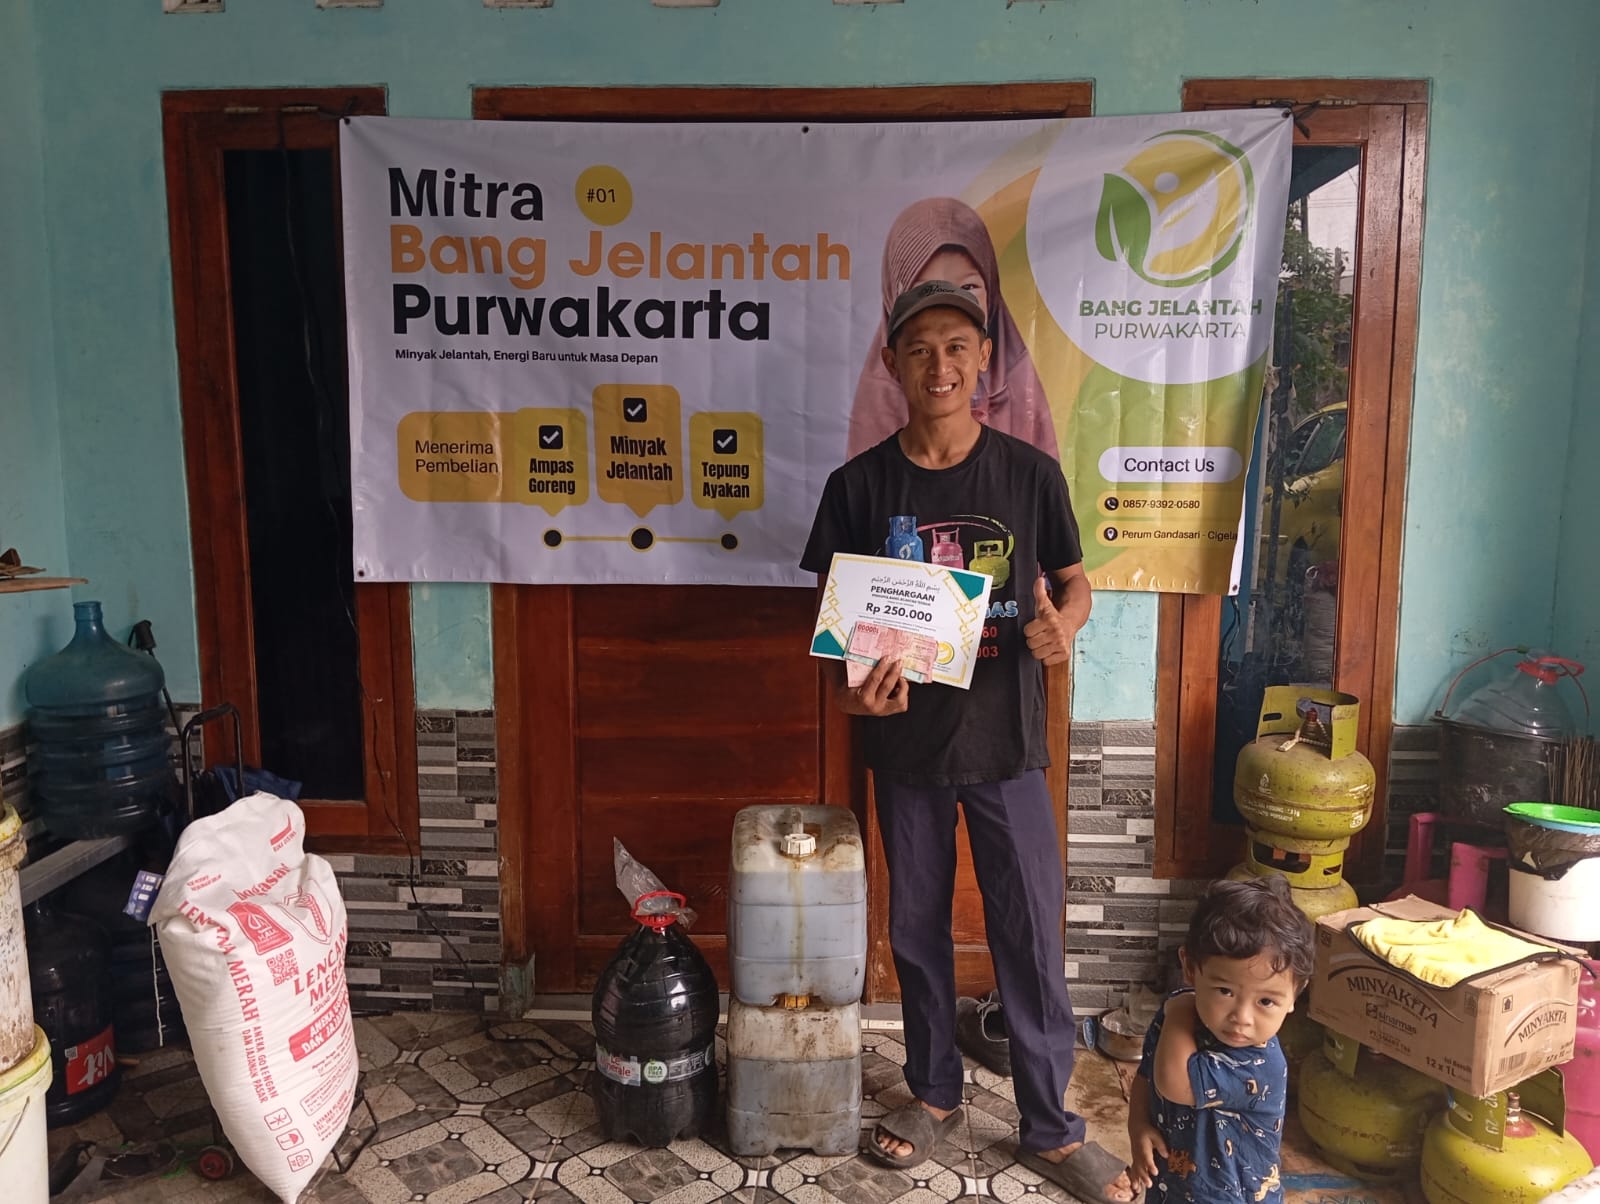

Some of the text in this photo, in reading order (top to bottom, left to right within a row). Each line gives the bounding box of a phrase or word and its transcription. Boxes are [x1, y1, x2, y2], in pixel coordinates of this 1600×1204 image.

[388, 167, 544, 221] Mitra
[586, 187, 616, 204] #01
[389, 224, 851, 289] Bang Jelantah
[392, 283, 770, 341] Purwakarta
[1079, 298, 1263, 317] BANG JELANTAH
[1094, 321, 1247, 339] PURWAKARTA
[395, 348, 658, 365] Minyak Jelantah, Energi Baru untuk Masa Depan
[415, 439, 494, 455] Menerima
[610, 435, 667, 458] Minyak
[415, 458, 498, 474] Pembelian
[529, 458, 574, 476] Ampas
[606, 460, 673, 482] Jelantah
[701, 462, 750, 480] Tepung
[1124, 457, 1215, 473] Contact Us
[528, 478, 576, 495] Goreng
[702, 481, 750, 499] Ayakan
[1122, 499, 1200, 509] 0857-9392-0580
[1122, 530, 1152, 539] Perum
[1153, 530, 1200, 539] Gandasari
[870, 585, 935, 602] PENGHARGAAN
[866, 602, 880, 615] Rp
[884, 605, 933, 622] 250.000
[985, 601, 1019, 618] AS
[178, 899, 237, 956] LENANA
[227, 959, 260, 1022] MERAH
[1346, 975, 1438, 1029] MINYAKITA
[1518, 1010, 1567, 1043] MINYAKITA
[301, 1032, 324, 1054] DAN
[242, 1028, 253, 1046] DAN
[253, 1079, 269, 1104] PASAR
[1426, 1056, 1436, 1068] 12
[1446, 1066, 1456, 1077] 1L
